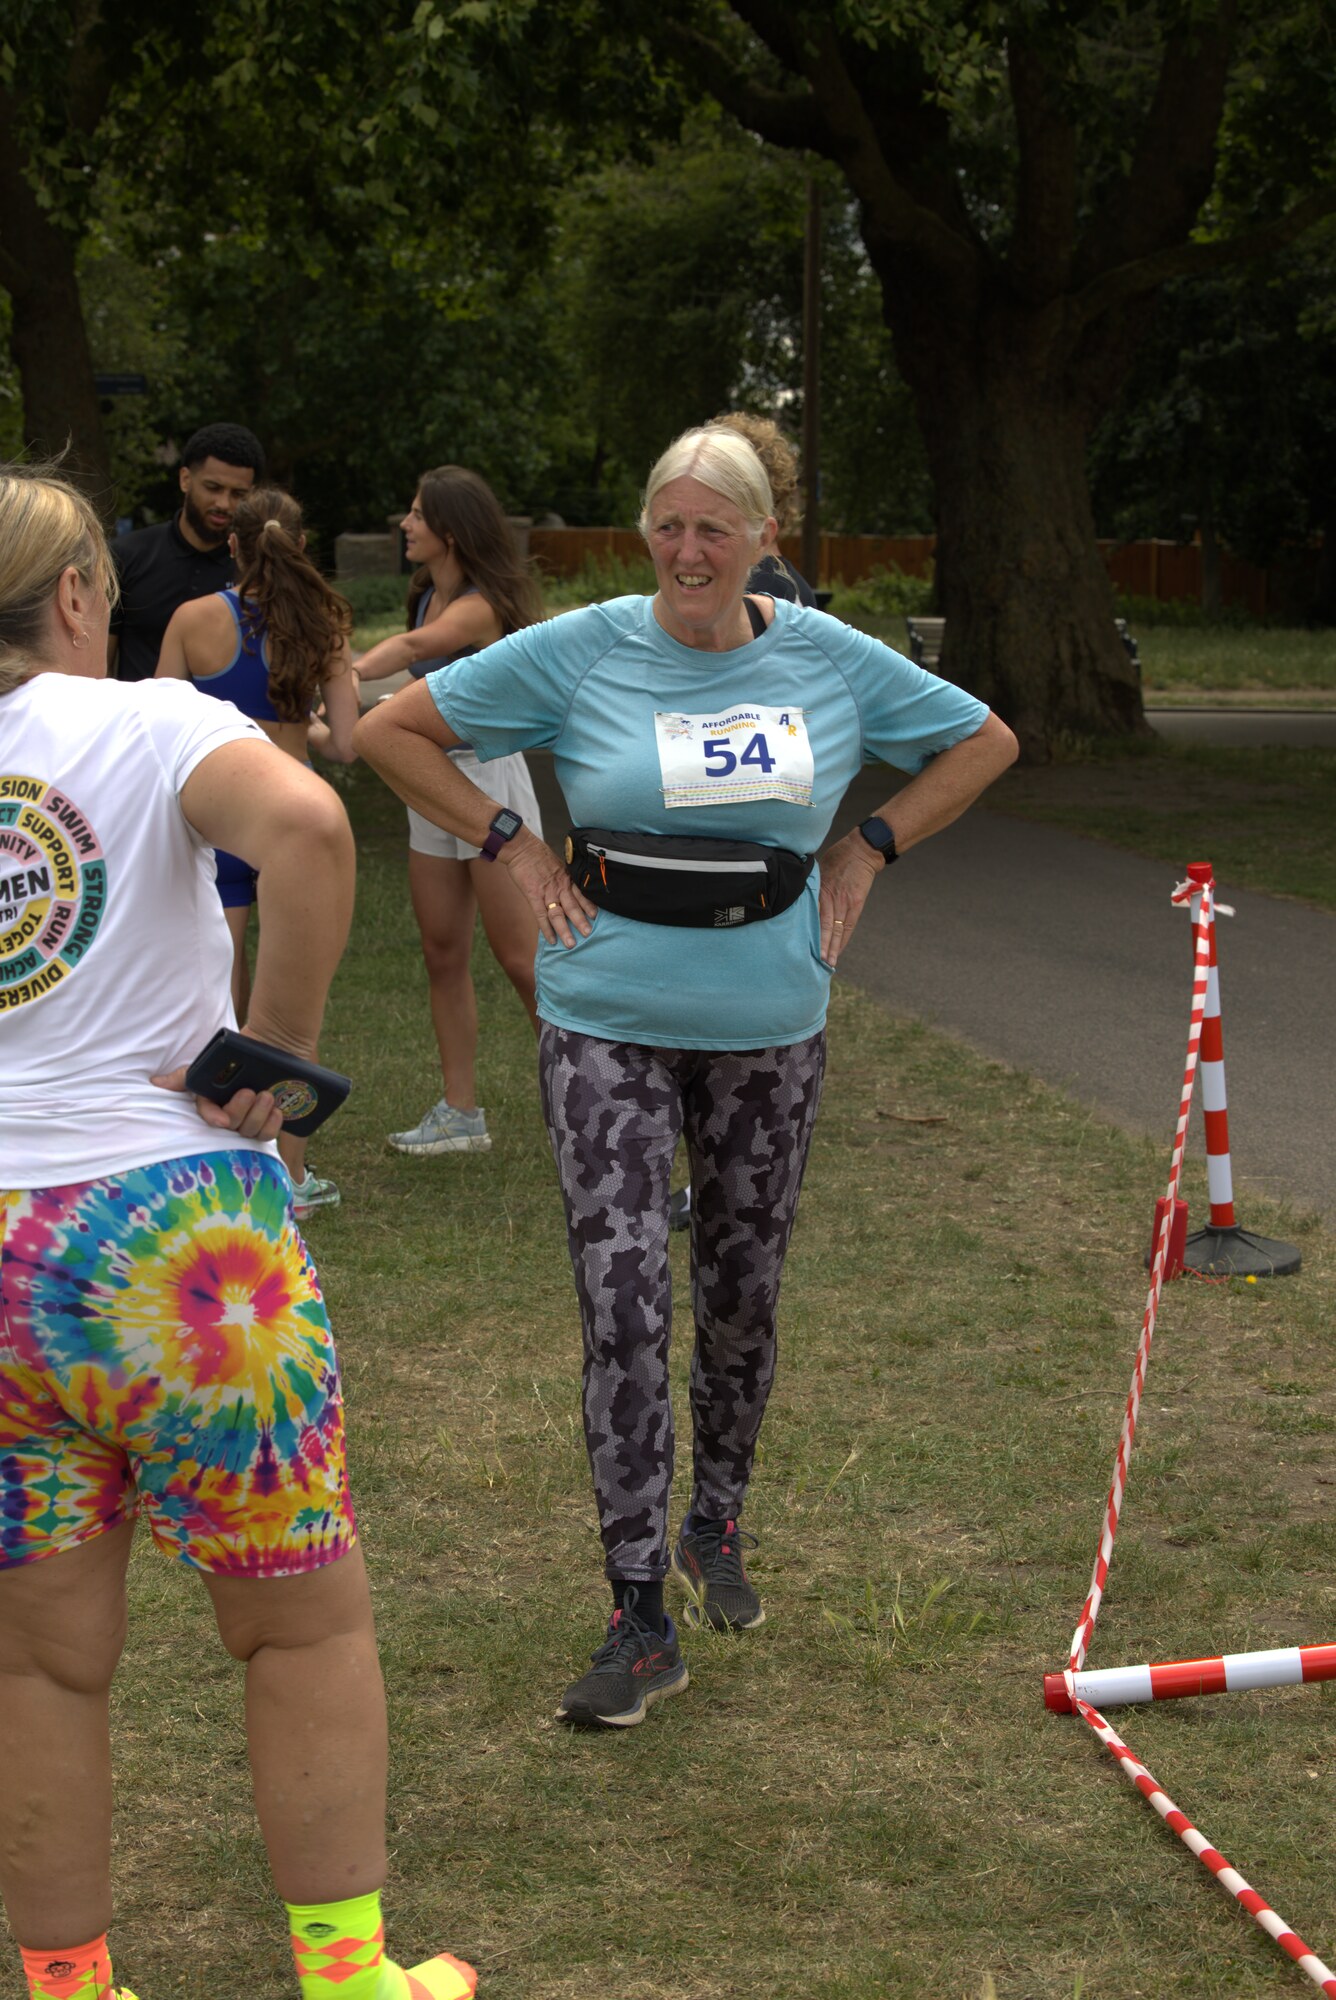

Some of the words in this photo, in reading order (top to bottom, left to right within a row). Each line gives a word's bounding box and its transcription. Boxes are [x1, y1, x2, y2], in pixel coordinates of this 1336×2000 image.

[701, 712, 761, 729] AFFORDABLE
[710, 721, 756, 736] RUNNING
[703, 733, 776, 777] 54
[46, 796, 96, 855] SWIM
[22, 812, 75, 892] SUPPORT
[42, 905, 71, 950] RUN
[63, 867, 104, 958] STRONG
